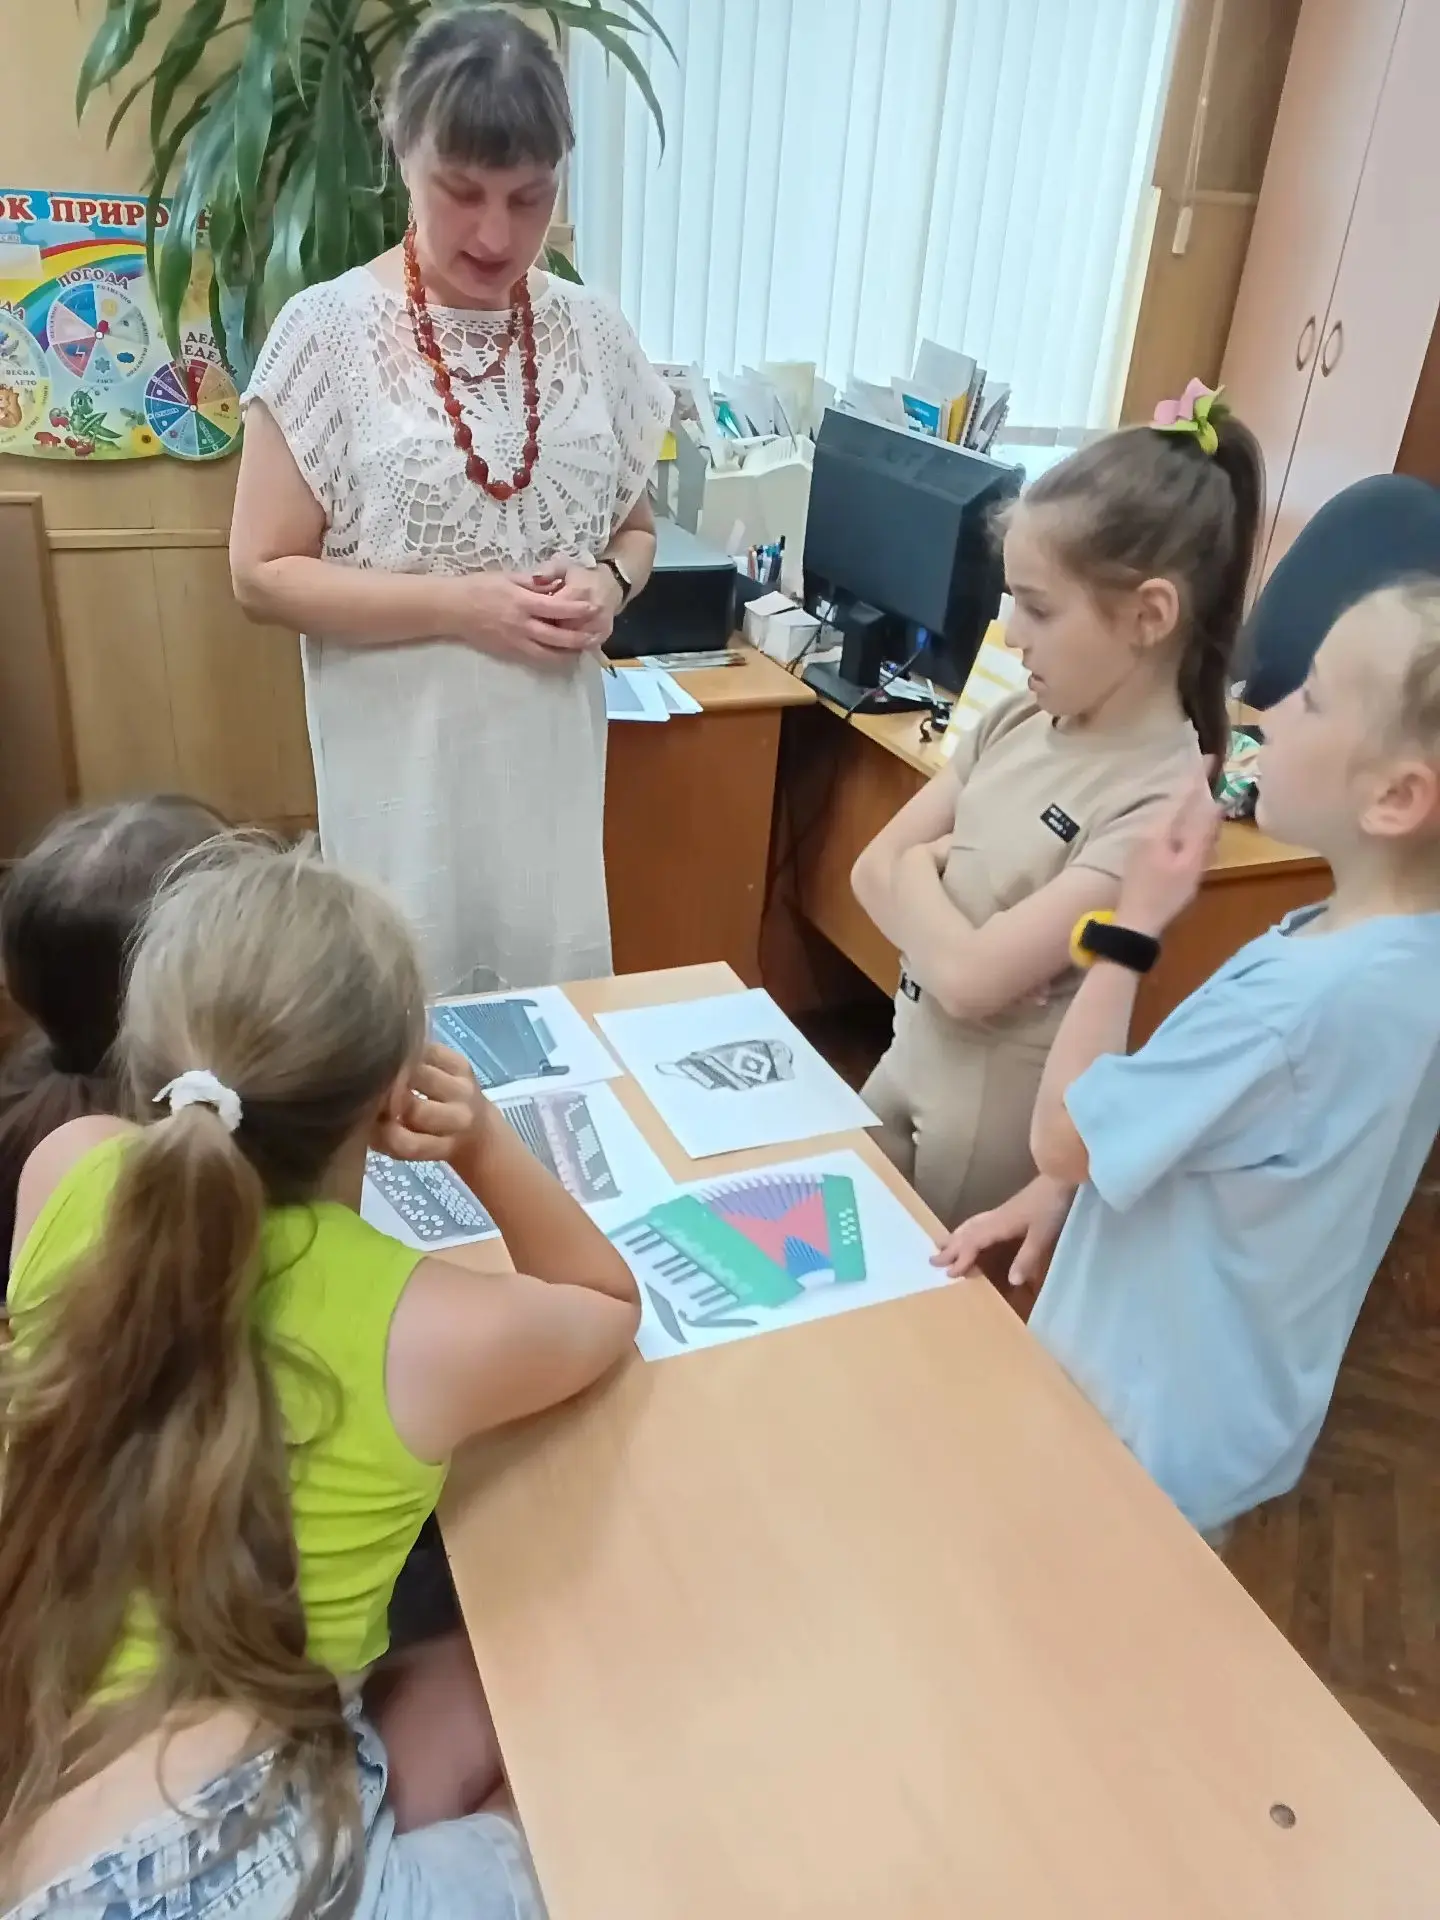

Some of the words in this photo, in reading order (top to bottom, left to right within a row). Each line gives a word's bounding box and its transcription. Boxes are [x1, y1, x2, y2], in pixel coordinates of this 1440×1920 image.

[0, 197, 34, 220] К
[51, 199, 211, 230] ПРИРО
[58, 268, 129, 290] ПОГОДА
[186, 331, 220, 350] ДЕН
